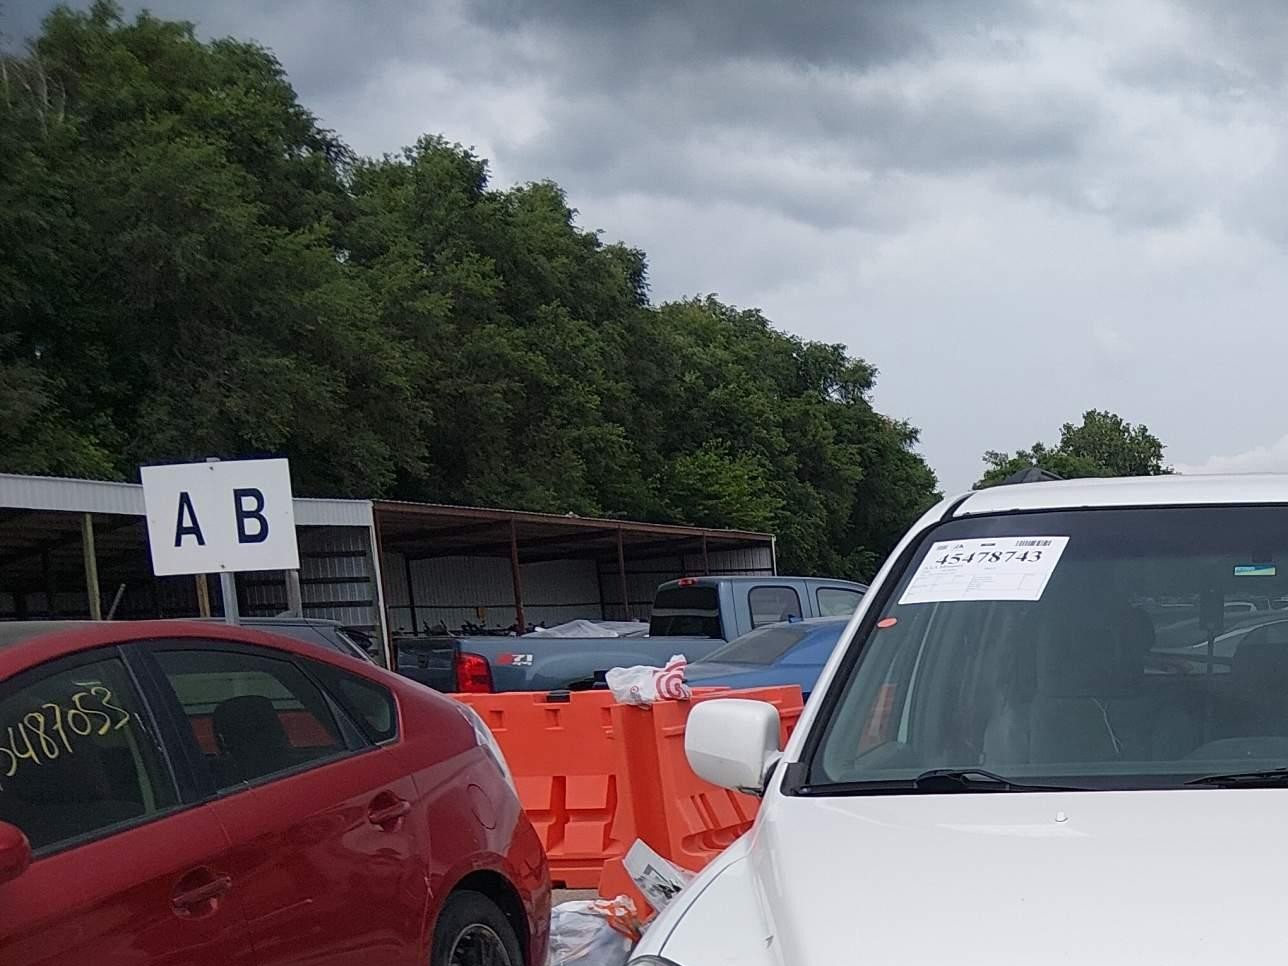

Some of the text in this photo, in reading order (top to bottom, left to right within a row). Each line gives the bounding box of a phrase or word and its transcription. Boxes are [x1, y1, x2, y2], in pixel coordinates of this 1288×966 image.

[174, 487, 269, 547] A B
[935, 551, 1043, 565] 45478743
